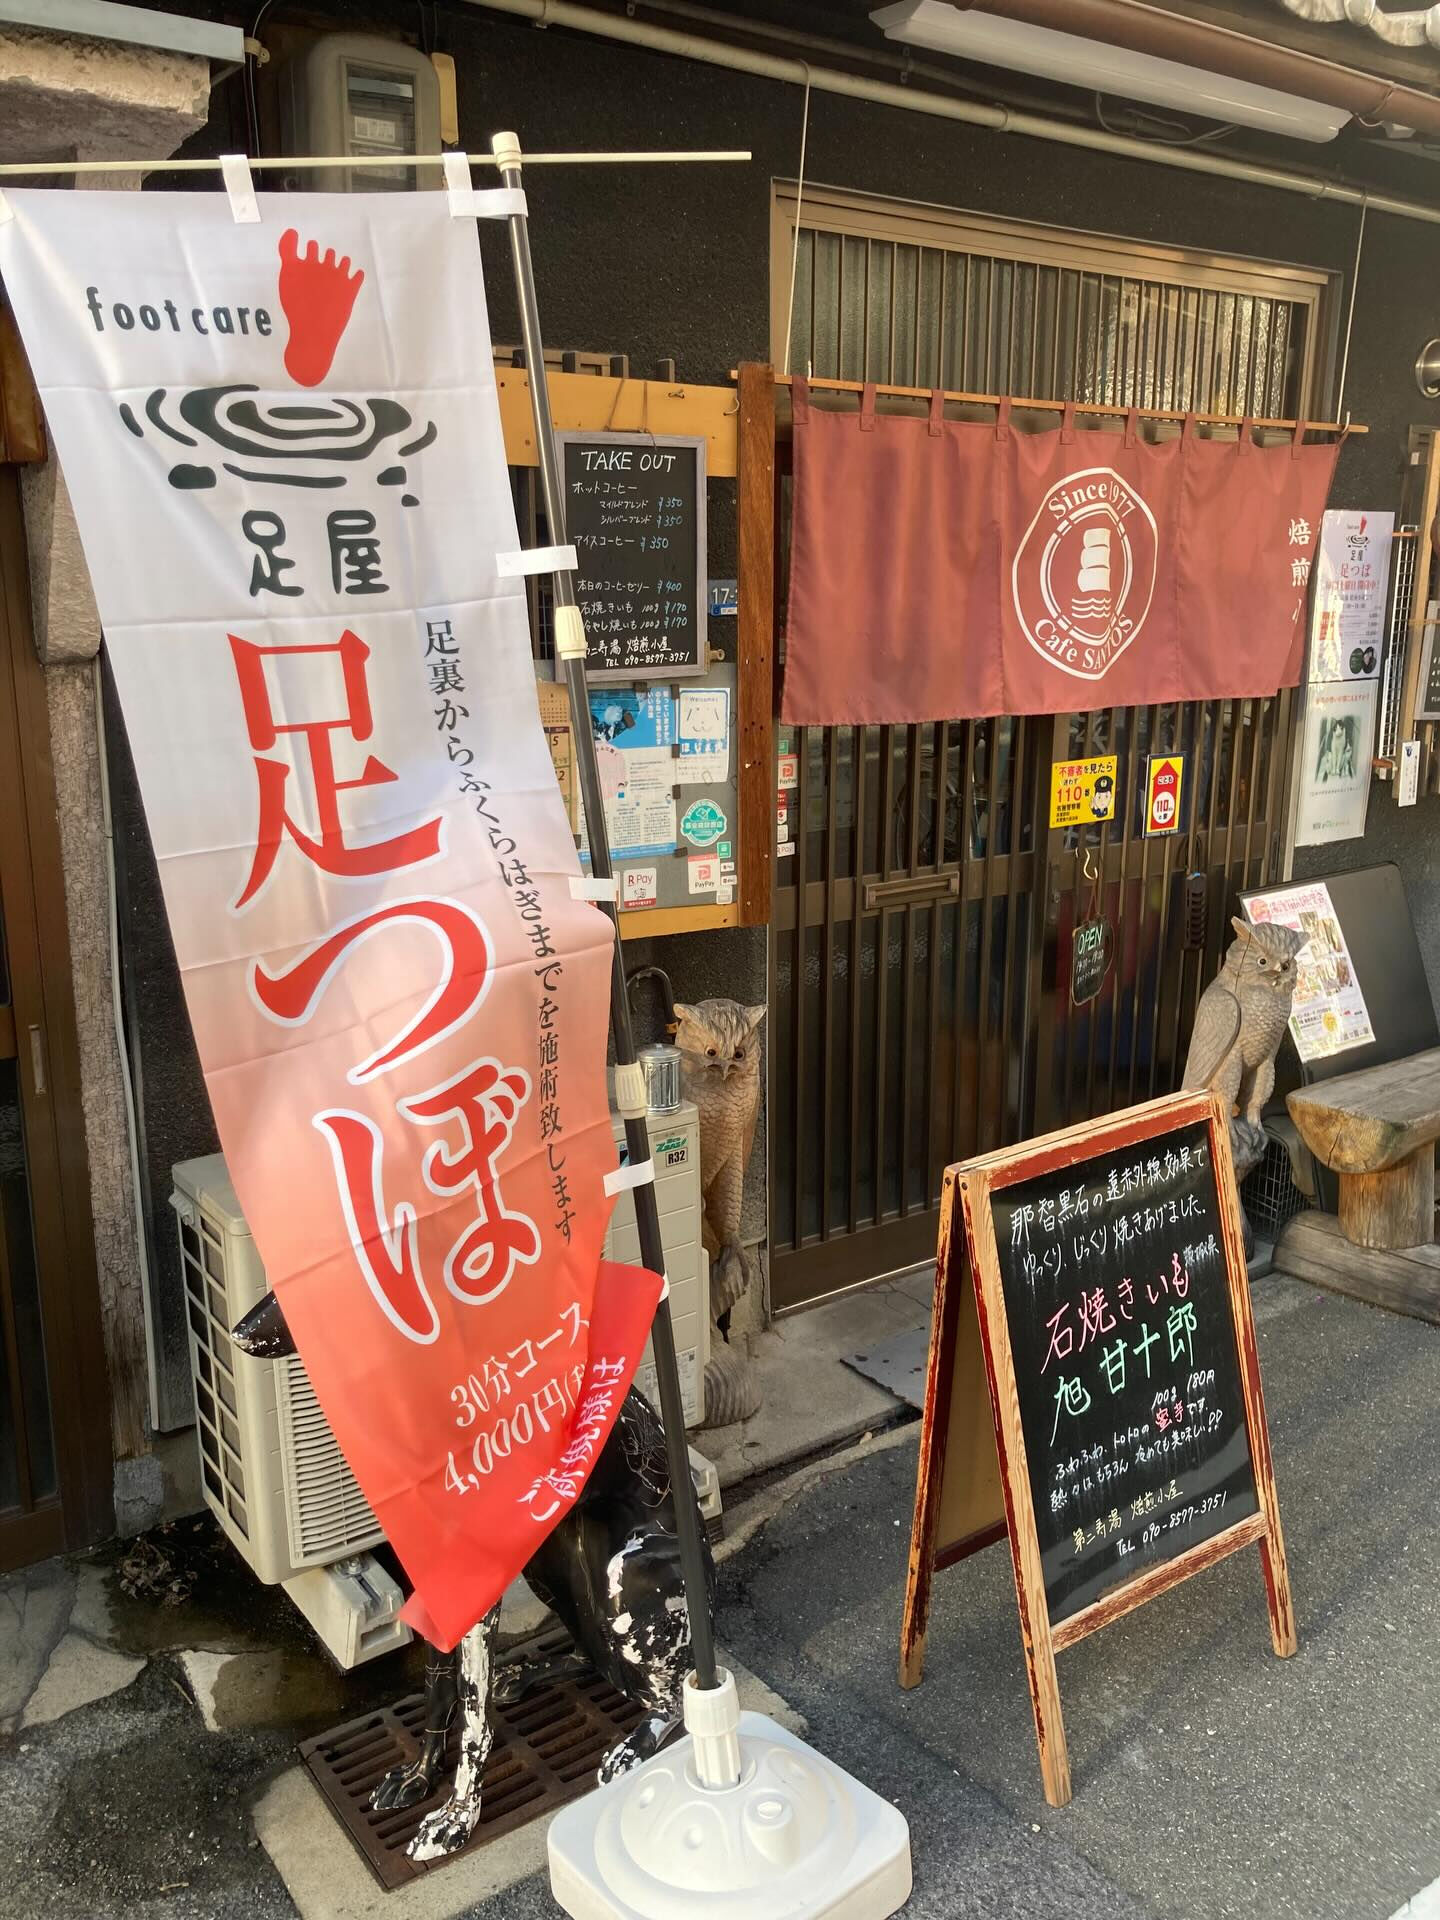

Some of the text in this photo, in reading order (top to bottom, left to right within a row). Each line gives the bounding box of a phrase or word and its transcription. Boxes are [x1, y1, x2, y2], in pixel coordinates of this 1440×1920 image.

[86, 286, 272, 337] foot care
[580, 450, 677, 474] TAKE OUT
[571, 481, 638, 495] ホットコーヒー
[1048, 480, 1136, 520] Since 1977
[599, 496, 683, 513] マイルドブレンド ¥350
[600, 514, 684, 529] シルバーブレンド ¥350
[242, 509, 390, 597] 足屋
[573, 535, 670, 553] アイスコーヒー ¥350
[577, 579, 682, 595] 本日のコーヒーゼリー ¥400
[712, 587, 737, 605] 17-
[580, 600, 687, 616] 石焼きいも 100g ¥170
[640, 619, 660, 630] 100g
[663, 616, 689, 630] ¥170
[626, 635, 672, 655] 焙煎小屋
[1034, 613, 1134, 670] Cafe SANTOS
[605, 651, 690, 668] TEL 090-8577-3751
[637, 874, 653, 885] Pay
[694, 880, 715, 889] PayPay
[423, 618, 578, 1246] 足裏からふくらはぎまでを施術致します
[1077, 924, 1103, 955] OPEN
[226, 628, 541, 1345] 足つぼ
[667, 1150, 686, 1165] R32
[1010, 1145, 1208, 1246] 那智黒石の遠赤外線効果で
[1041, 1252, 1189, 1375] 石焼きいも
[451, 1301, 590, 1427] 30分コース
[1151, 1369, 1216, 1410] 100g 180円
[1072, 1479, 1184, 1554] 第二寿湯 焙煎小屋
[1115, 1490, 1227, 1556] TEL 090-8577-3751
